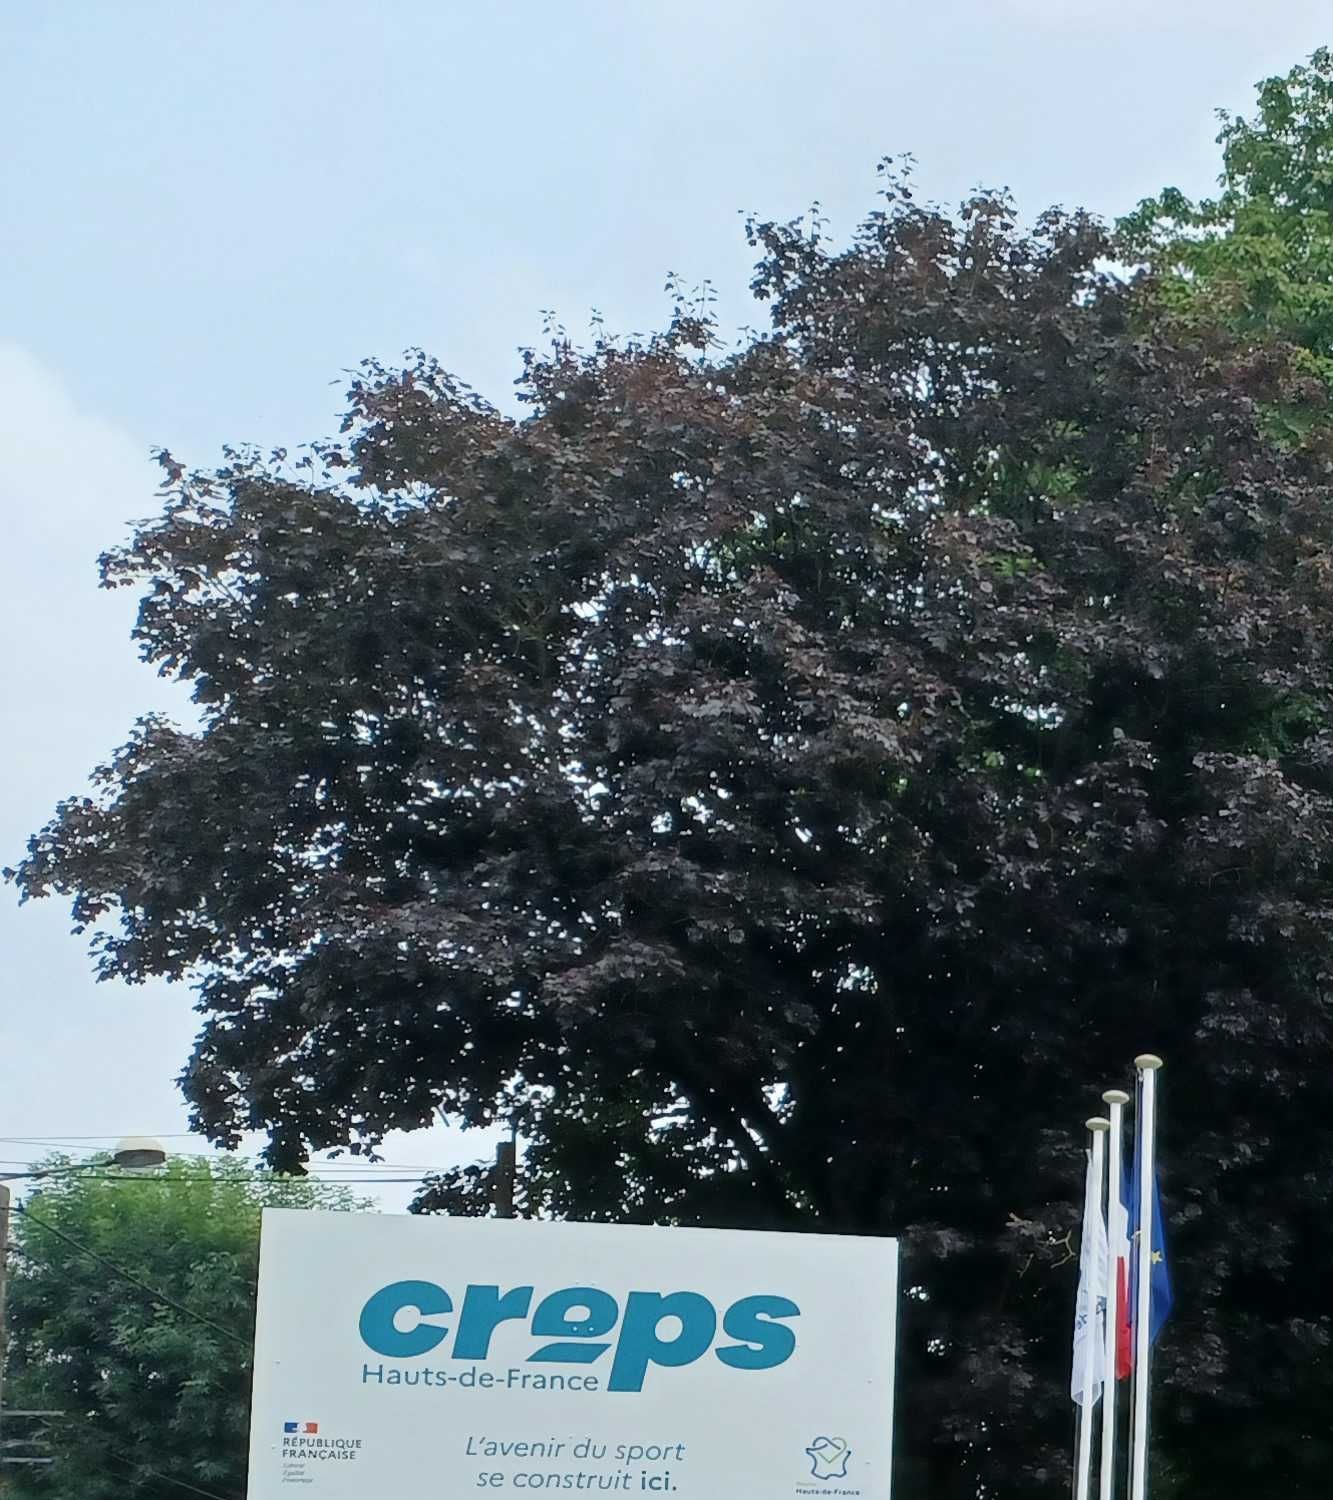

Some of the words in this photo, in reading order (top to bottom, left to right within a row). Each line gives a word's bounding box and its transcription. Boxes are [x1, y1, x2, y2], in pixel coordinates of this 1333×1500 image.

[359, 1280, 801, 1393] creps
[362, 1363, 599, 1392] Hauts-de-France
[281, 1449, 357, 1460] FRANÇAISE
[282, 1436, 362, 1449] RÉPUBLIQUE
[465, 1436, 566, 1458] L'avenir
[572, 1438, 607, 1459] du
[614, 1442, 687, 1466] sport
[476, 1471, 505, 1487] se
[512, 1469, 633, 1490] construit
[640, 1470, 678, 1491] ici.
